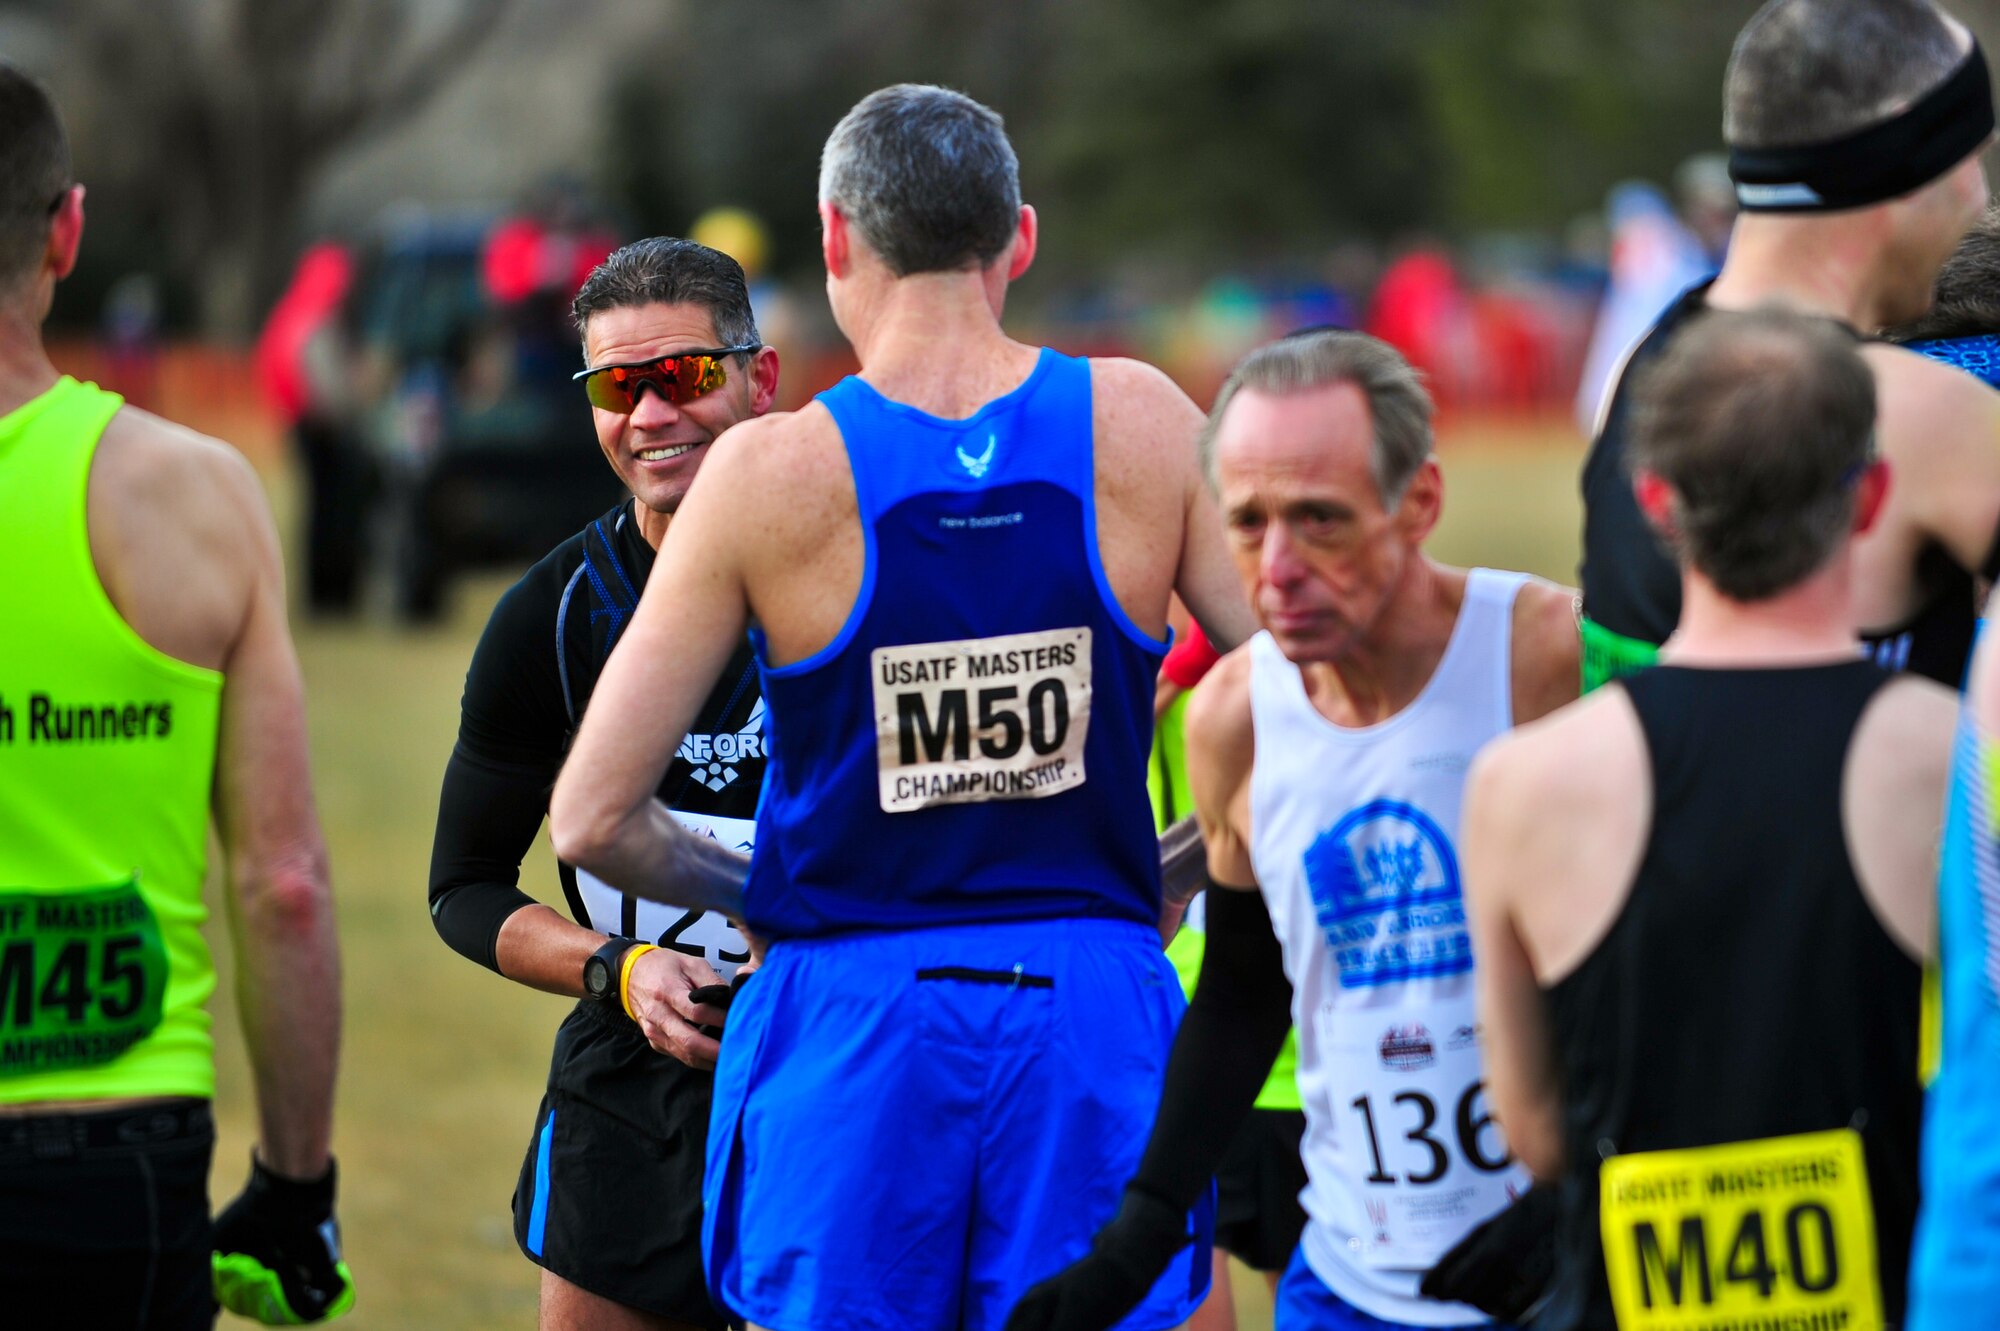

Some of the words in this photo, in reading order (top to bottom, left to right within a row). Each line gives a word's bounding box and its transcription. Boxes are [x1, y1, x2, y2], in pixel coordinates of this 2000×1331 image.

[882, 656, 957, 686] USATF
[968, 643, 1076, 679] MASTERS
[30, 692, 172, 742] Runners
[896, 677, 1069, 766] M50
[896, 757, 1066, 800] CHAMPIONSHIP
[1350, 1080, 1513, 1186] 136
[1633, 1203, 1838, 1309] M40
